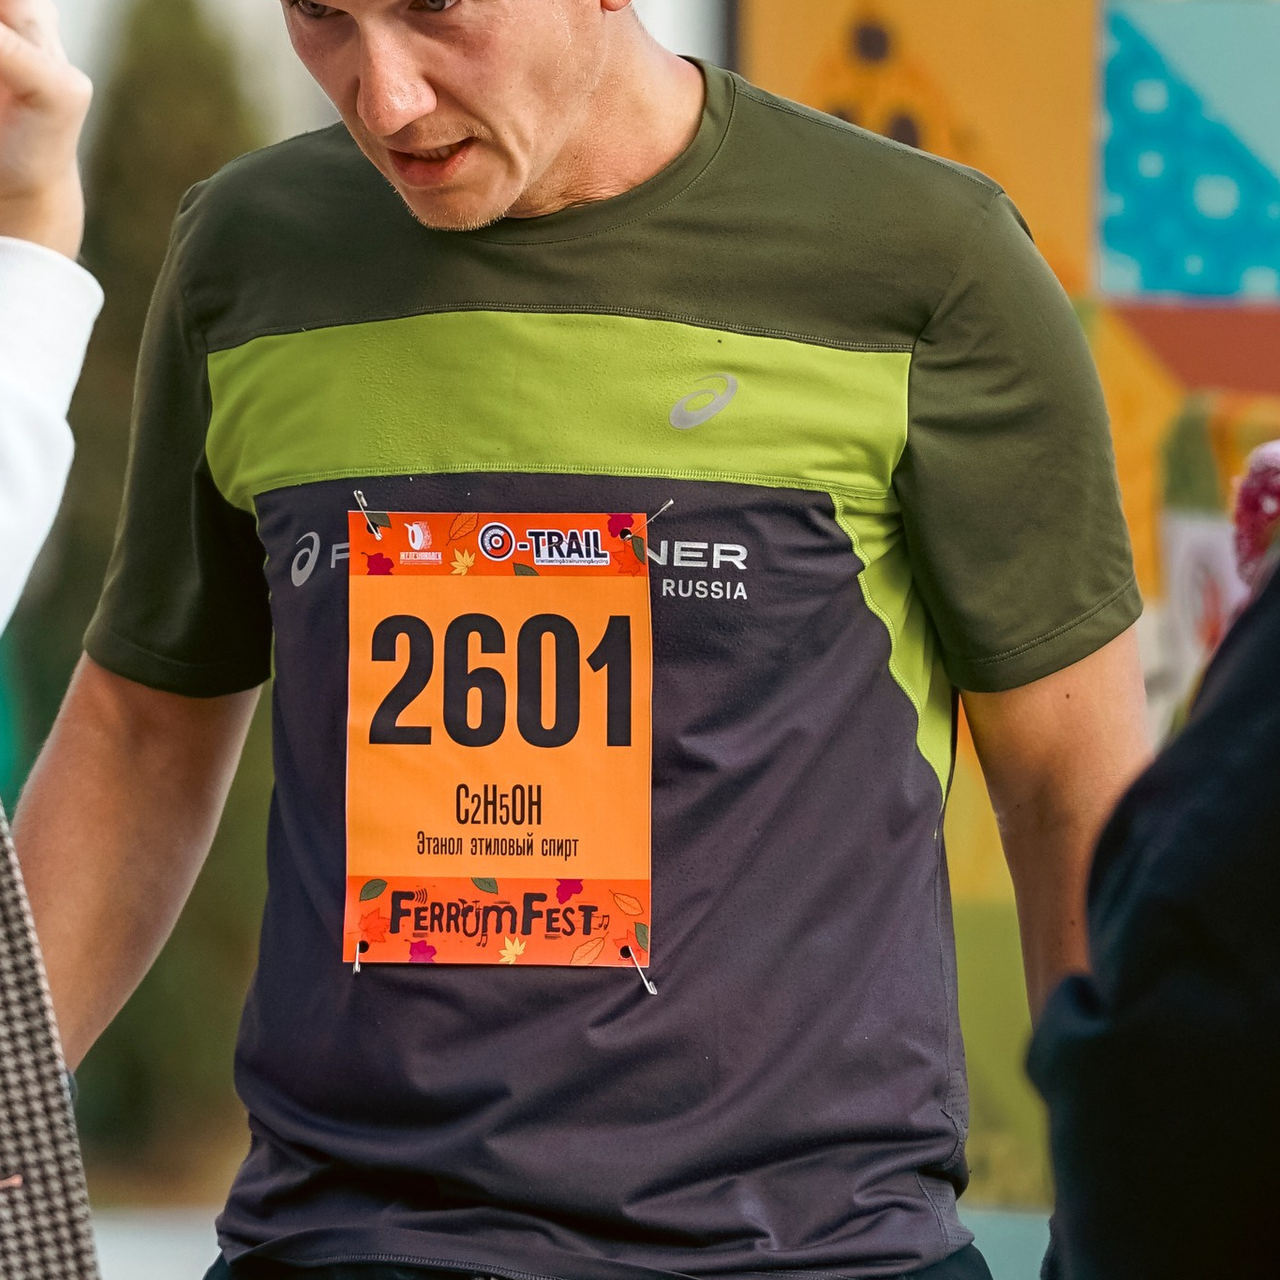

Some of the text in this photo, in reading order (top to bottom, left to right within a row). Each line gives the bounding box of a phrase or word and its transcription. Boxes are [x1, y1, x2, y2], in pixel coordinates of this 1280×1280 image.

[662, 578, 748, 601] RUSSIA
[369, 613, 632, 748] 2601
[455, 783, 542, 825] C2H5OH
[416, 831, 580, 861] Этанол этиловый спирт
